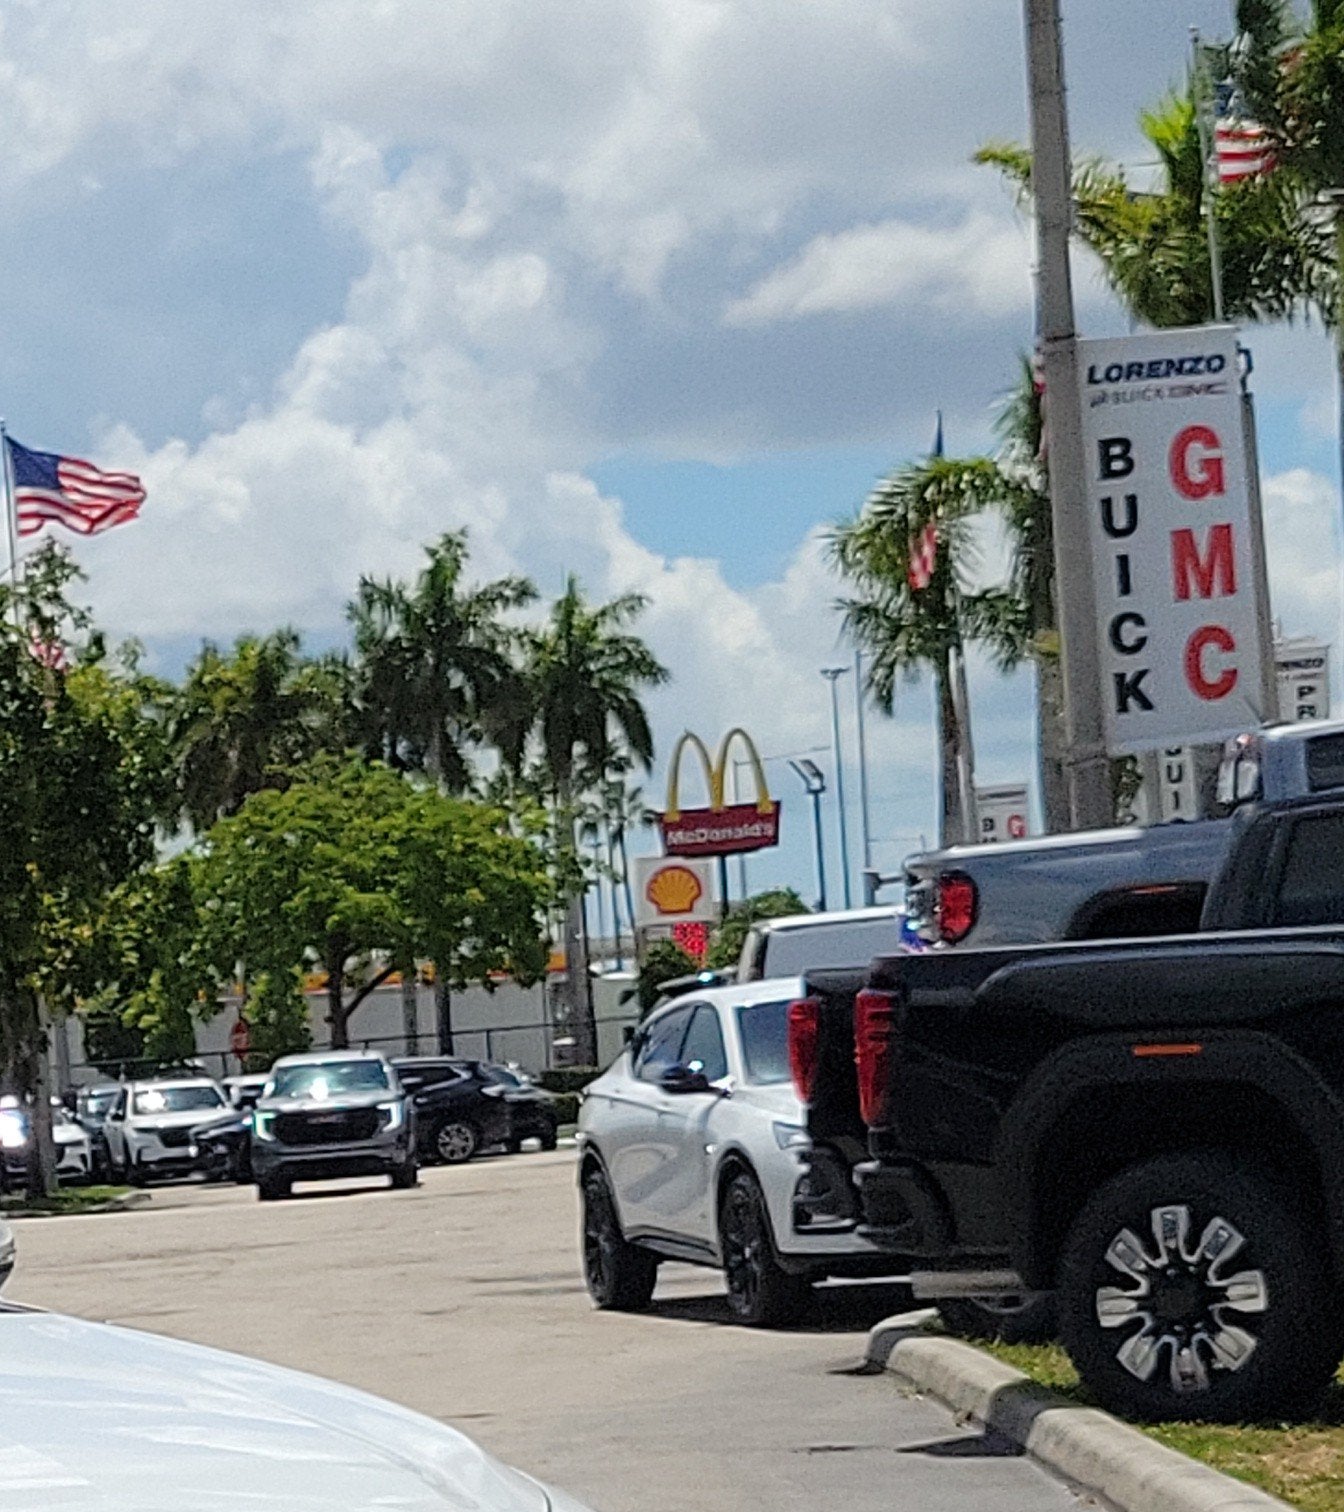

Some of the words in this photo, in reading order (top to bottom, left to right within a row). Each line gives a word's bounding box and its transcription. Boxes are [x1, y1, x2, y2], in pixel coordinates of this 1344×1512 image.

[1087, 354, 1226, 385] LORENZO
[1098, 437, 1154, 713] BUICK
[1169, 425, 1239, 701] GMC
[667, 823, 774, 845] McDonald's
